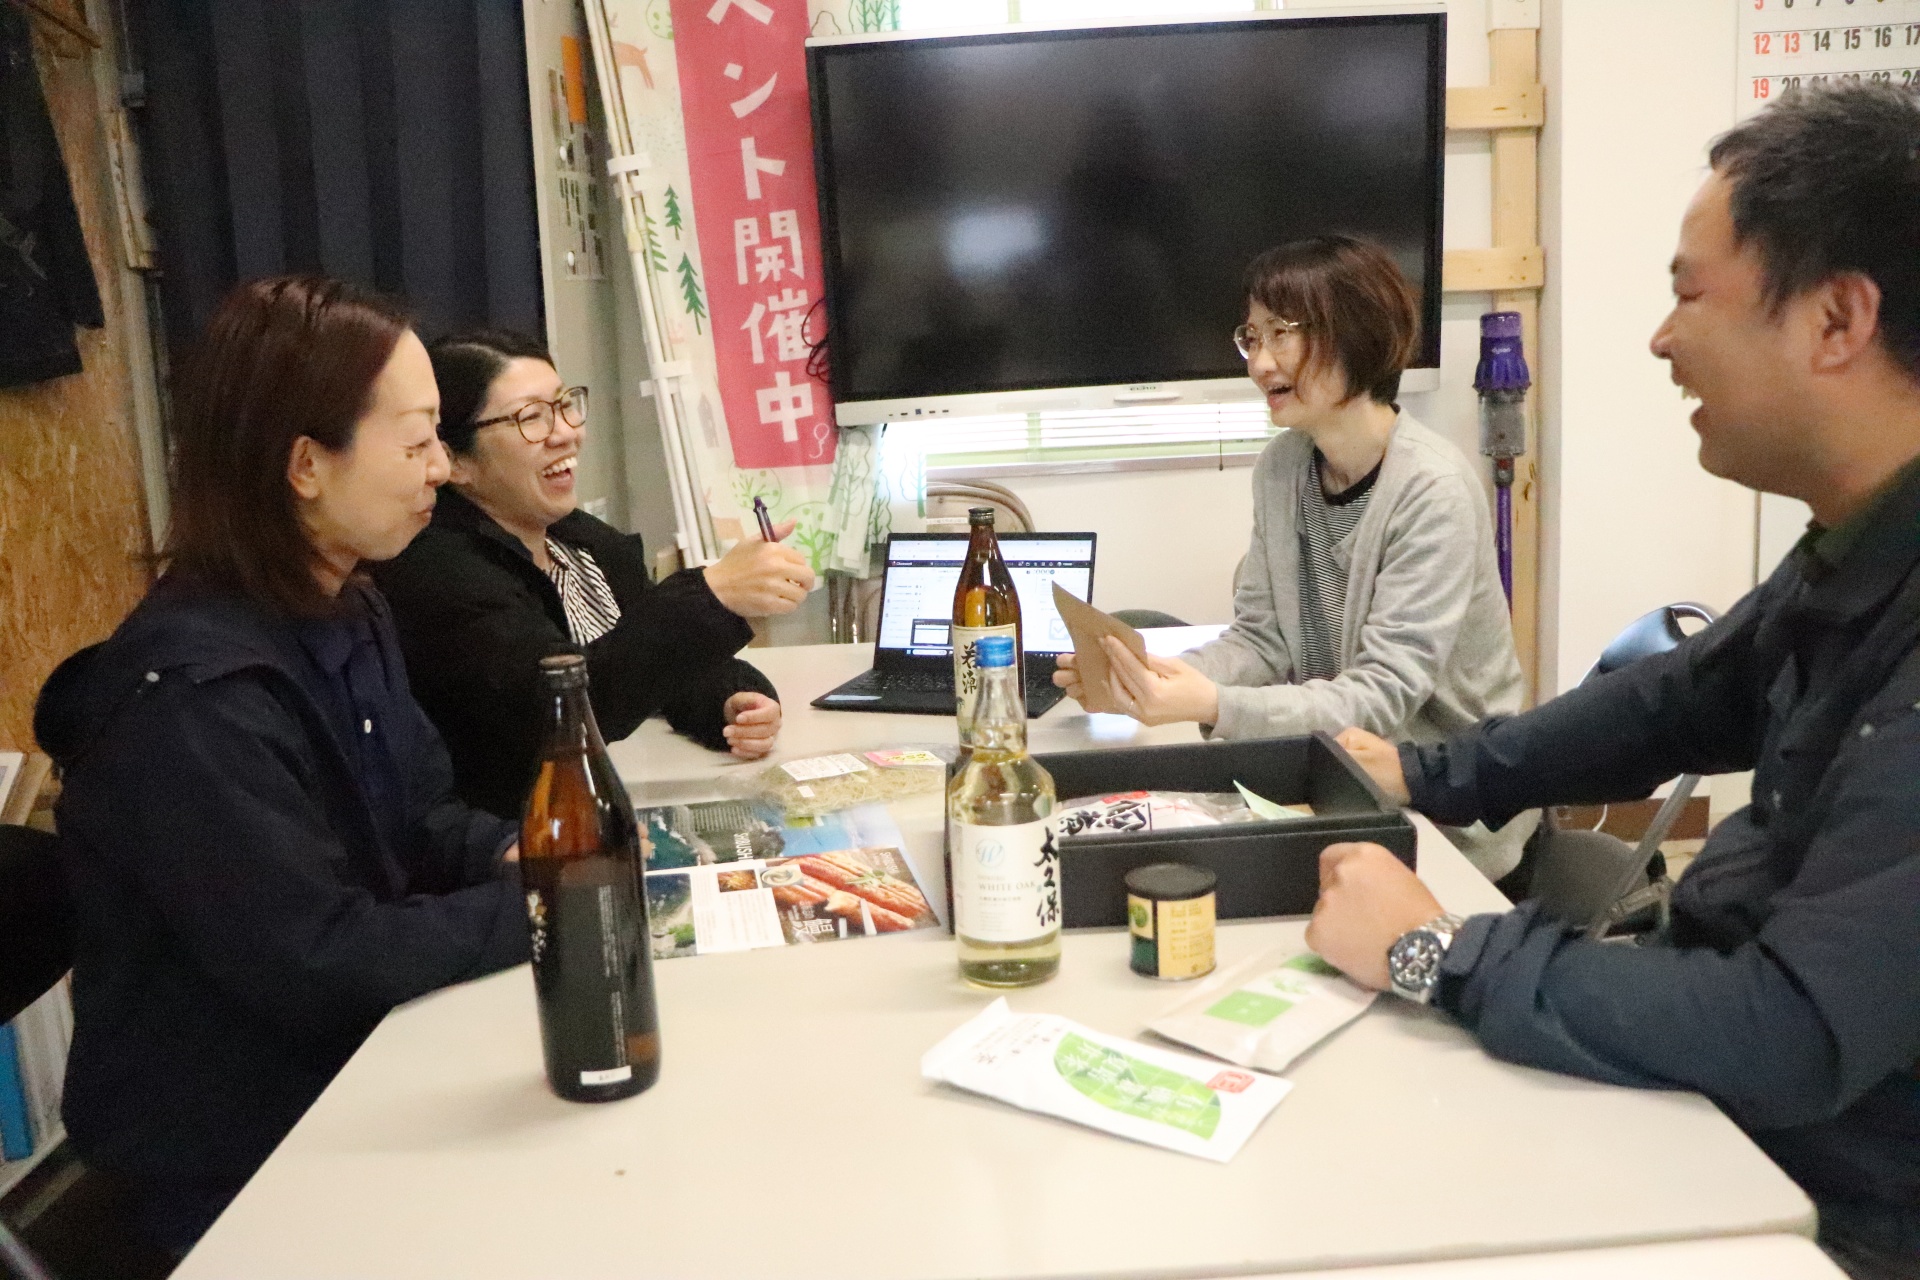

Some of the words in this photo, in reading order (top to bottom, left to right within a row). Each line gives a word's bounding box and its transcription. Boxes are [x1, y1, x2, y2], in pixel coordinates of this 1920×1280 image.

[1753, 33, 1771, 55] 12
[1783, 32, 1800, 53] 13
[1813, 30, 1831, 51] 14
[1843, 28, 1861, 50] 15
[1874, 26, 1892, 48] 16
[1753, 77, 1770, 99] 19
